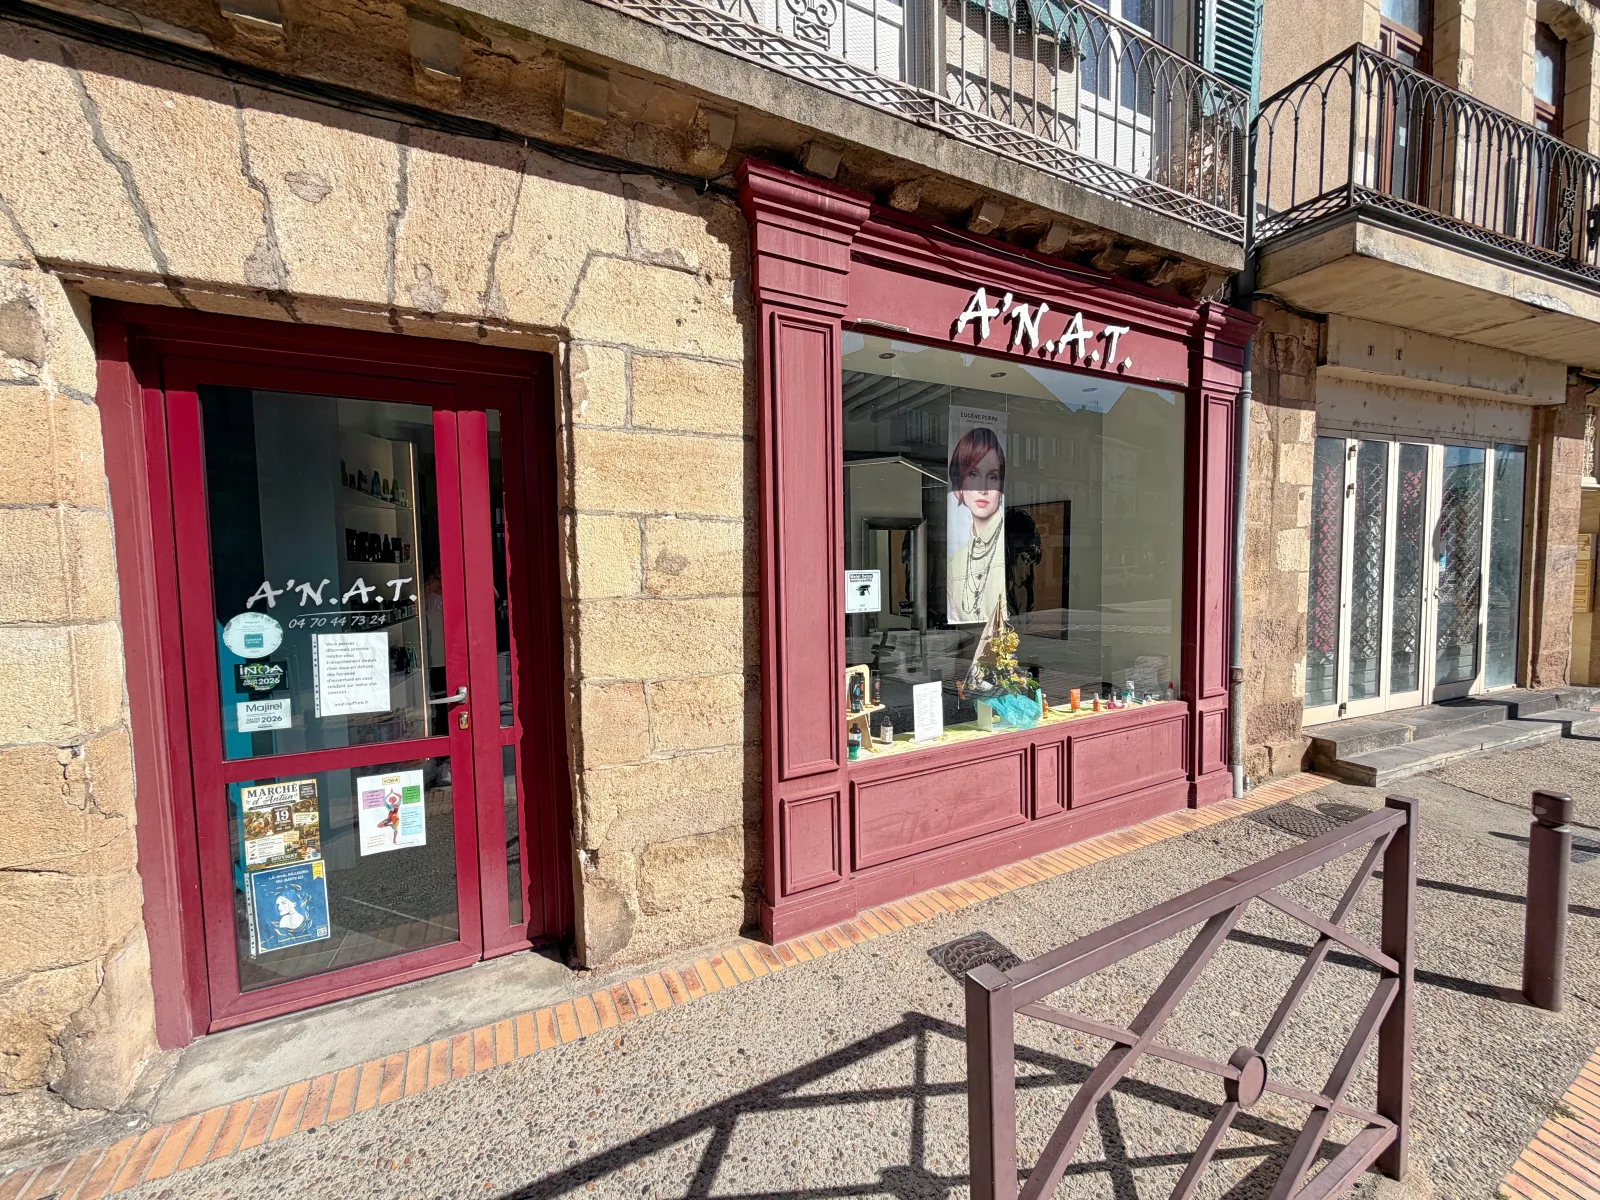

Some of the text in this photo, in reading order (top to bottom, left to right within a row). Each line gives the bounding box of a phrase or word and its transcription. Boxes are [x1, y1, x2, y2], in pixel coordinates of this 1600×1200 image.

[957, 287, 1132, 369] A'N.A.T.
[246, 577, 417, 609] A'N.A.T.
[288, 615, 386, 629] 04 70 44 73 24
[258, 677, 280, 685] 2026
[246, 702, 282, 712] Majirel
[261, 715, 282, 723] 2026
[247, 784, 298, 799] MARCHÉ
[275, 810, 289, 821] 19
